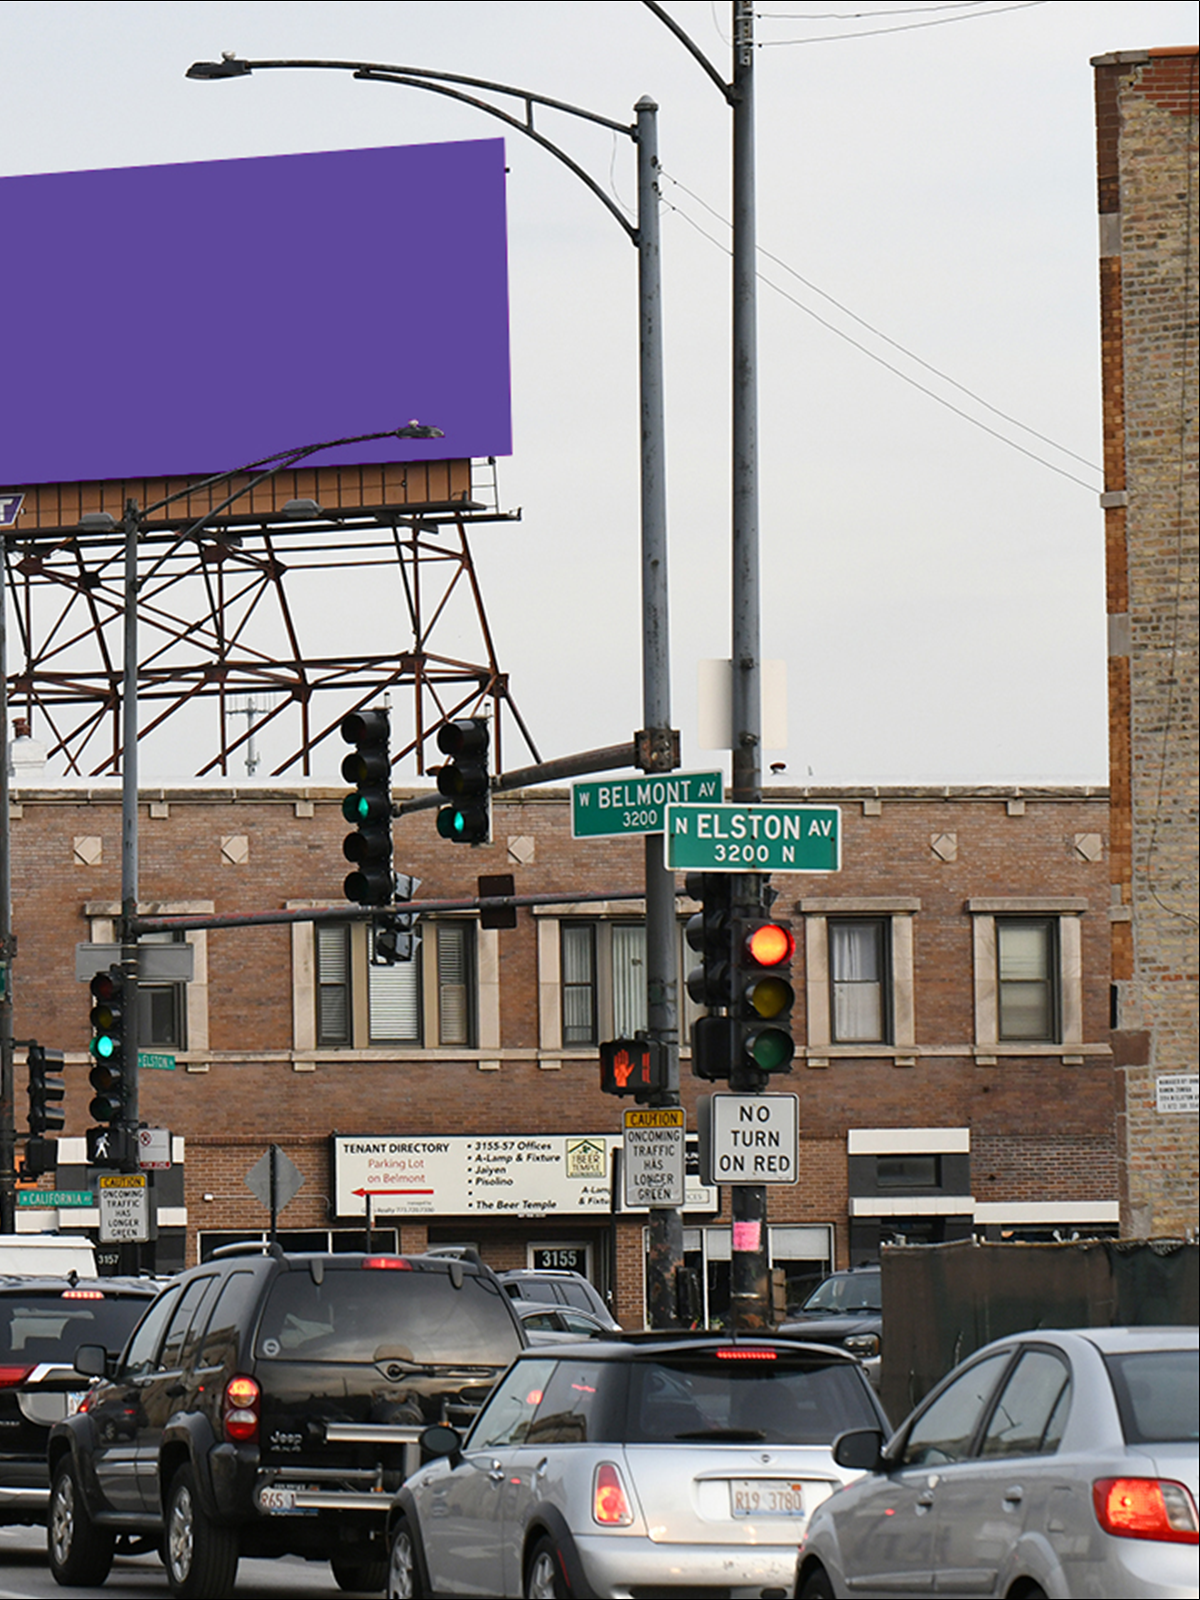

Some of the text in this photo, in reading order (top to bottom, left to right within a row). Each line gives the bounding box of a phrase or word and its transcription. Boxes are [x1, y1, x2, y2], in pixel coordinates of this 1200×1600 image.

[578, 780, 716, 809] W BELMONT AV
[622, 810, 658, 828] 3200
[675, 813, 833, 840] N ELSTON AV
[714, 844, 795, 863] 3200 N
[630, 1112, 679, 1126] CAUTION
[739, 1105, 770, 1123] NO
[628, 1130, 681, 1142] ONCOMING
[730, 1130, 780, 1148] TURN
[343, 1142, 450, 1154] TENANT DIRECTORY
[474, 1140, 552, 1151] 3155-57 Offices
[633, 1145, 675, 1157] TRAFFIC
[367, 1158, 425, 1171] Parking Lot
[474, 1153, 561, 1164] A-Lamp & Fixture
[643, 1158, 664, 1170] HAS
[719, 1155, 745, 1172] ON
[754, 1155, 790, 1172] RED
[474, 1165, 507, 1176] Jaiyen
[103, 1180, 142, 1188] CAUTION
[367, 1173, 426, 1184] on Belmont
[475, 1177, 514, 1186] Pisolino
[634, 1174, 674, 1186] LONGER
[28, 1193, 82, 1205] CALIFORNIA
[102, 1190, 144, 1199] ONCOMING
[637, 1188, 672, 1201] GREEN
[107, 1200, 140, 1208] TRAFFIC
[476, 1200, 557, 1211] The Beer Temple
[115, 1209, 132, 1217] HAS
[108, 1219, 140, 1228] LONGER
[110, 1228, 138, 1237] GREEN
[98, 1254, 119, 1264] 3157
[541, 1250, 577, 1267] 3155
[270, 1430, 303, 1446] Jeep
[735, 1490, 802, 1511] R19 3780
